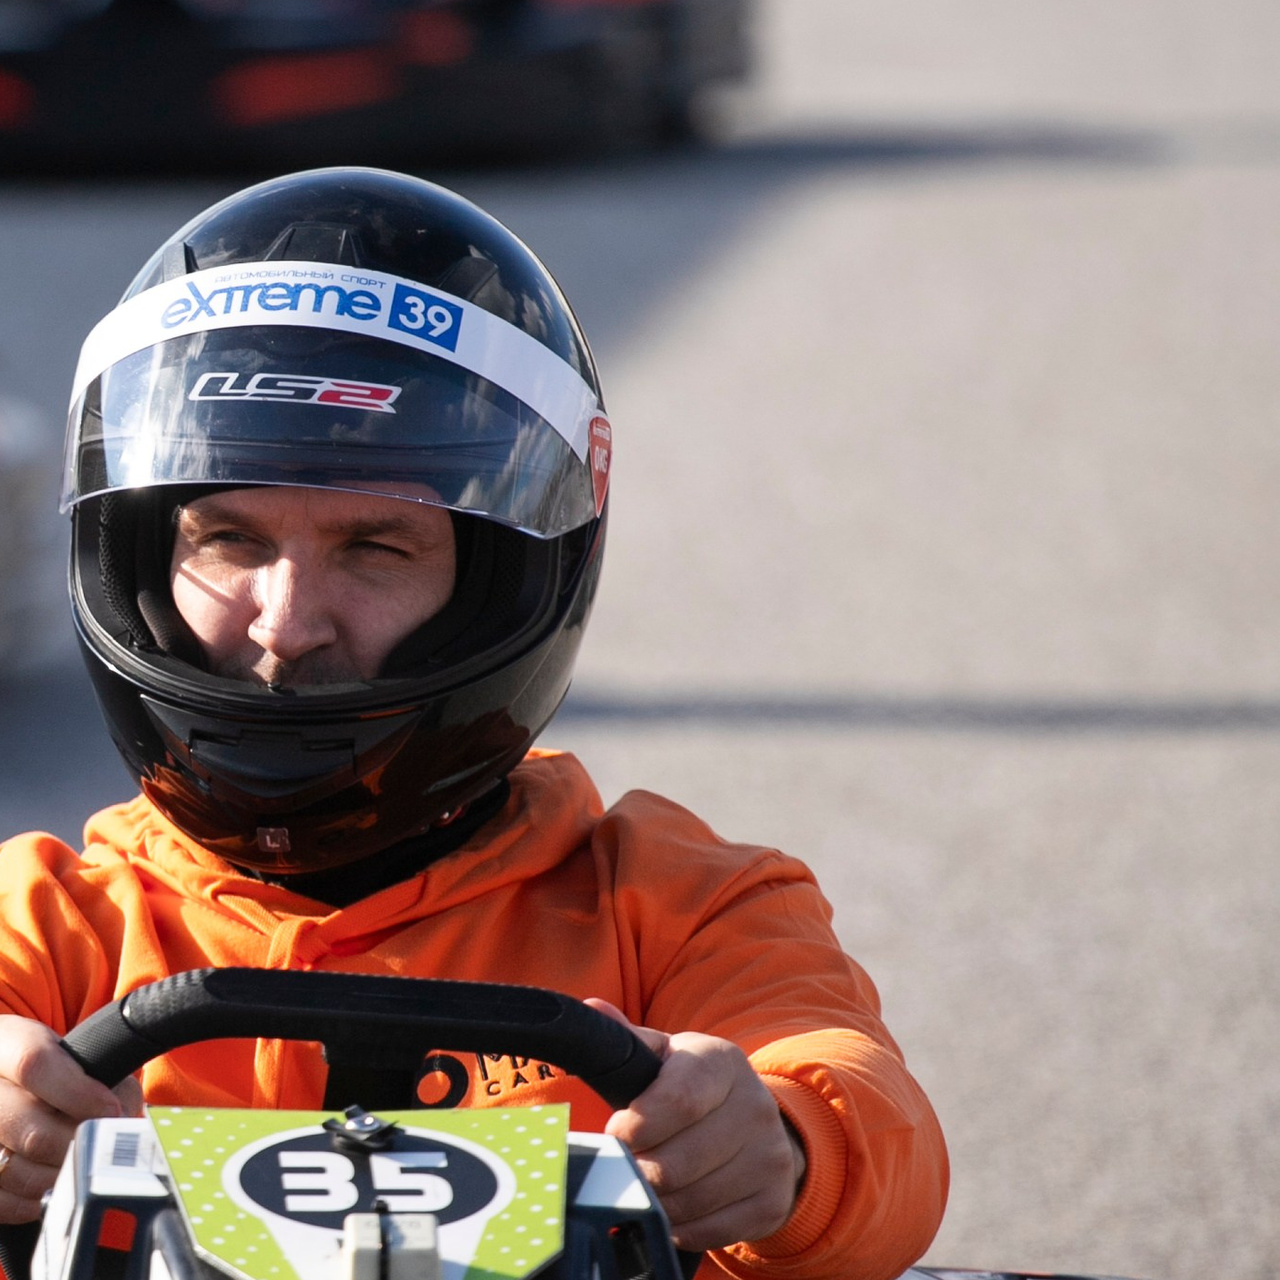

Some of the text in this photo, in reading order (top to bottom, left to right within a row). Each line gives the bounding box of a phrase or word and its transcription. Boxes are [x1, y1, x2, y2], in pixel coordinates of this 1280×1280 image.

[340, 273, 387, 289] СПОРТ
[398, 295, 454, 338] 39
[189, 371, 403, 414] LS2
[277, 1150, 454, 1213] 35
